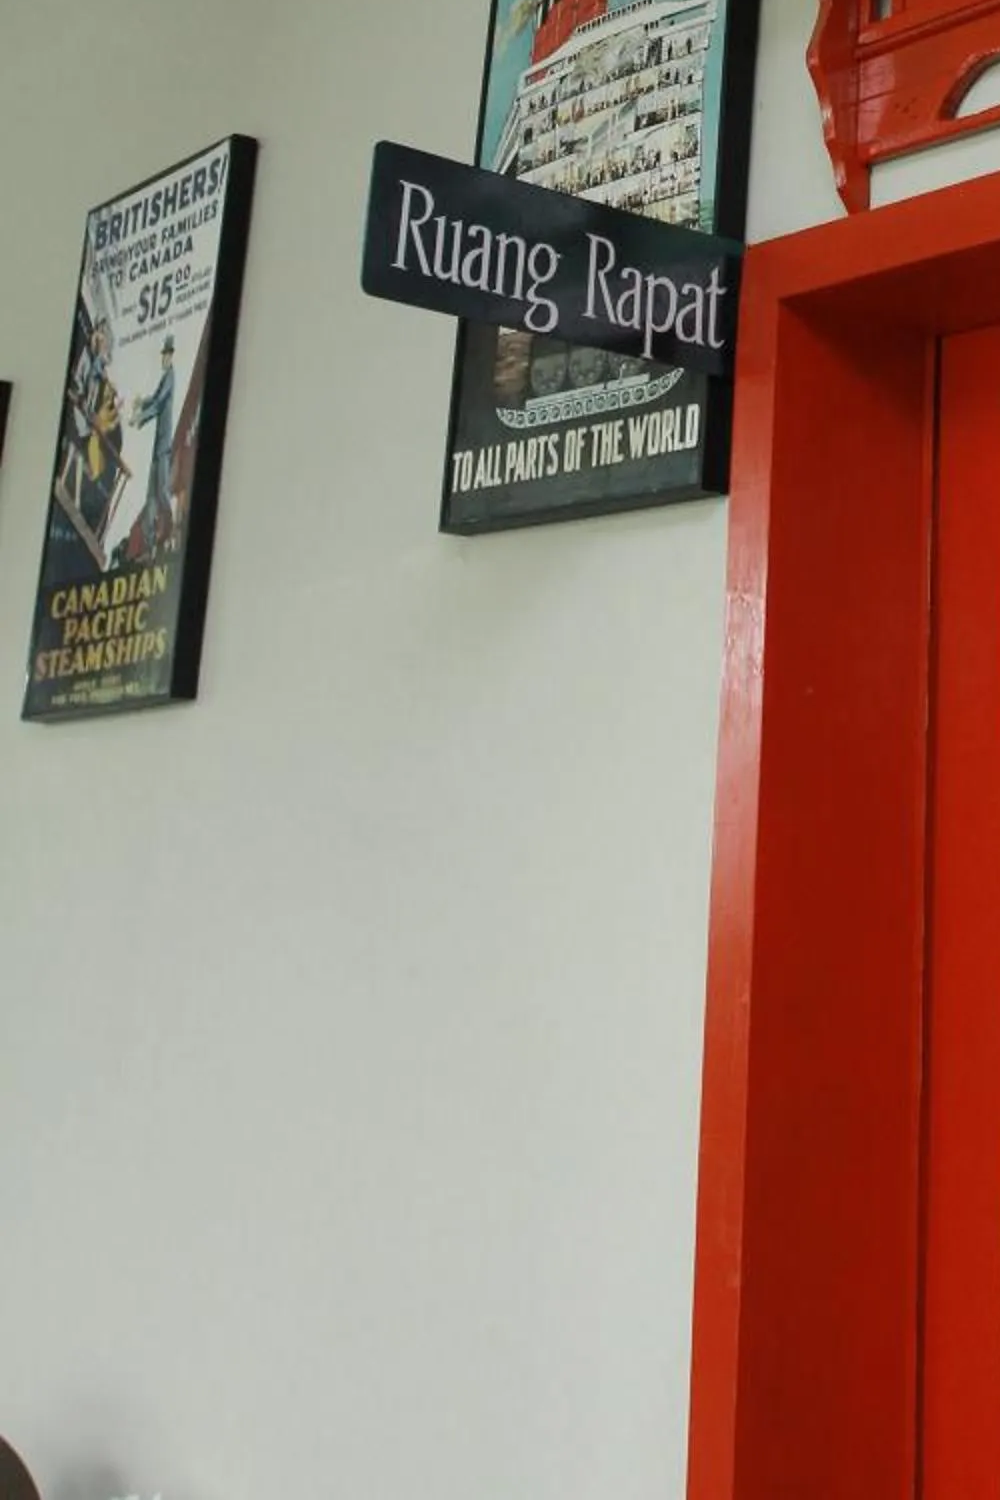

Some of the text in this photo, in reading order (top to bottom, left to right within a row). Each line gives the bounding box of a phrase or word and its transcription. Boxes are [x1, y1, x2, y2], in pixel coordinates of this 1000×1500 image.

[94, 154, 229, 250] BRITISHERS!
[128, 233, 157, 261] YOUR
[161, 199, 219, 245] FAMILIES
[129, 235, 194, 281] CANADA
[391, 179, 728, 360] Ruang Rapat
[452, 403, 700, 493] TO ALL PARTS OF THE WORLD
[52, 565, 168, 619] CANADIAN
[63, 602, 149, 645] PACIFIC
[34, 627, 167, 681] STEAMSHIPS
